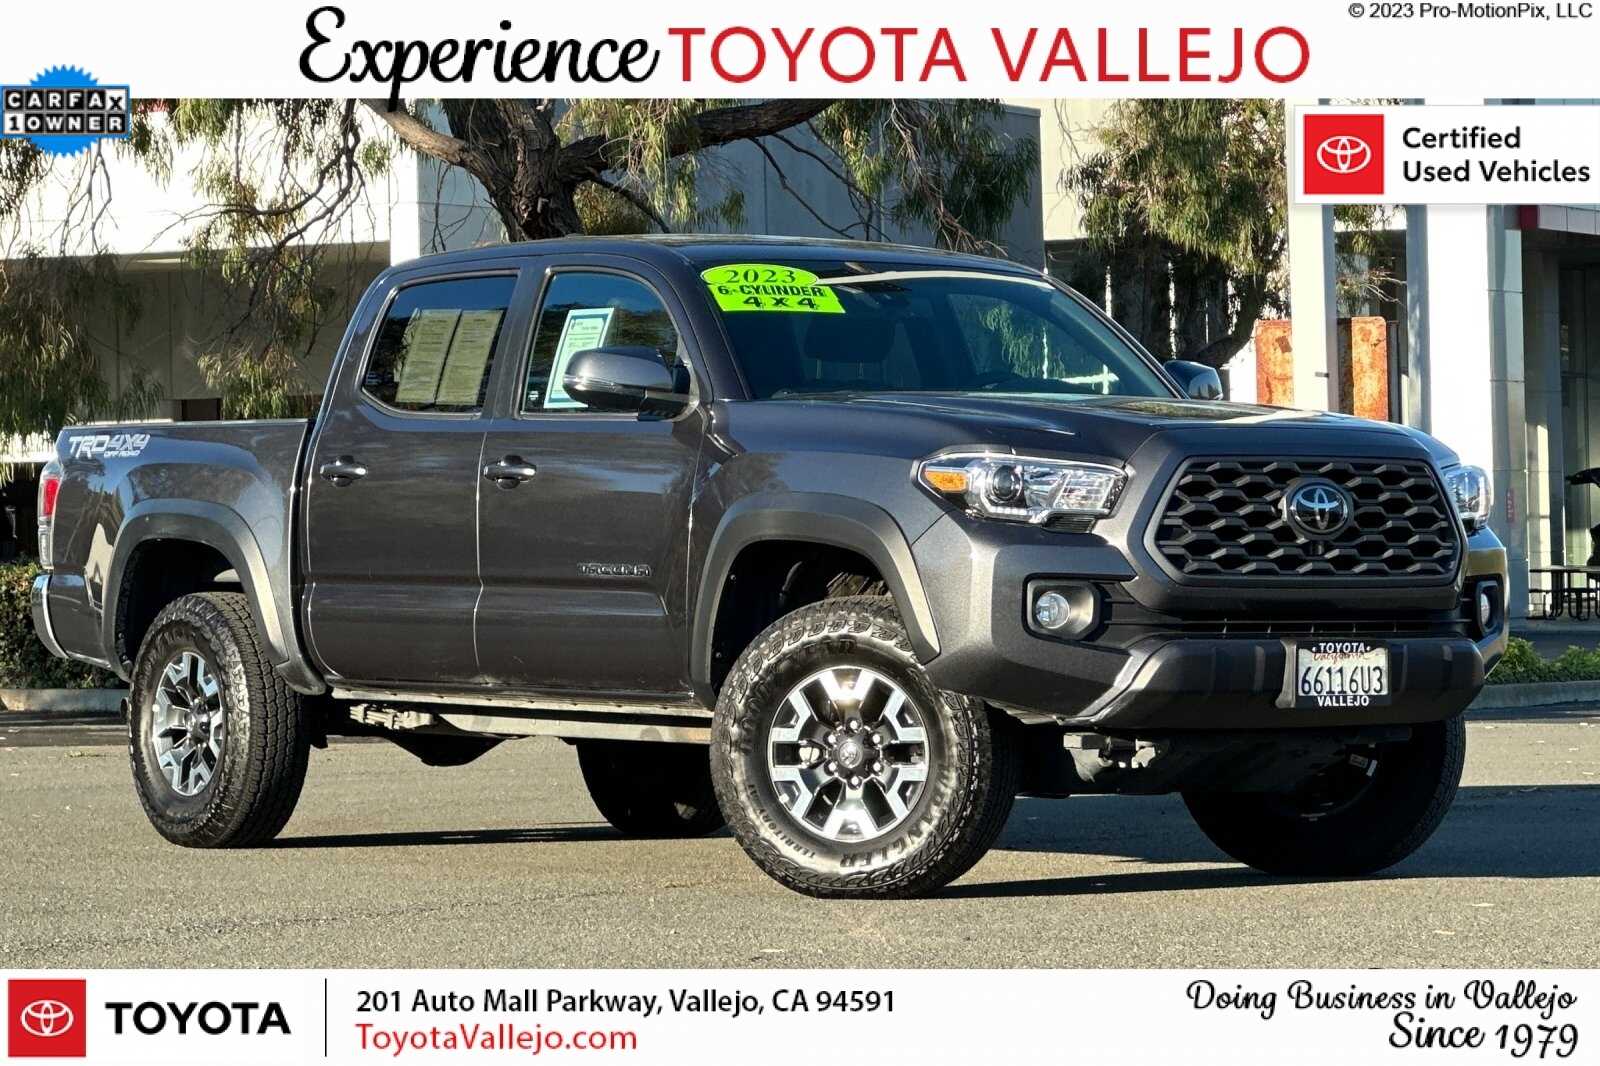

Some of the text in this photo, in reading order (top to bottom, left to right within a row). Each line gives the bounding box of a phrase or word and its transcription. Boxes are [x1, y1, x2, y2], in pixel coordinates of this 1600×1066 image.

[725, 269, 797, 284] 2023
[69, 435, 110, 459] TRD
[1319, 642, 1365, 653] TOYOTA
[1301, 666, 1383, 695] 66116U3
[1317, 695, 1370, 707] VALLEJO
